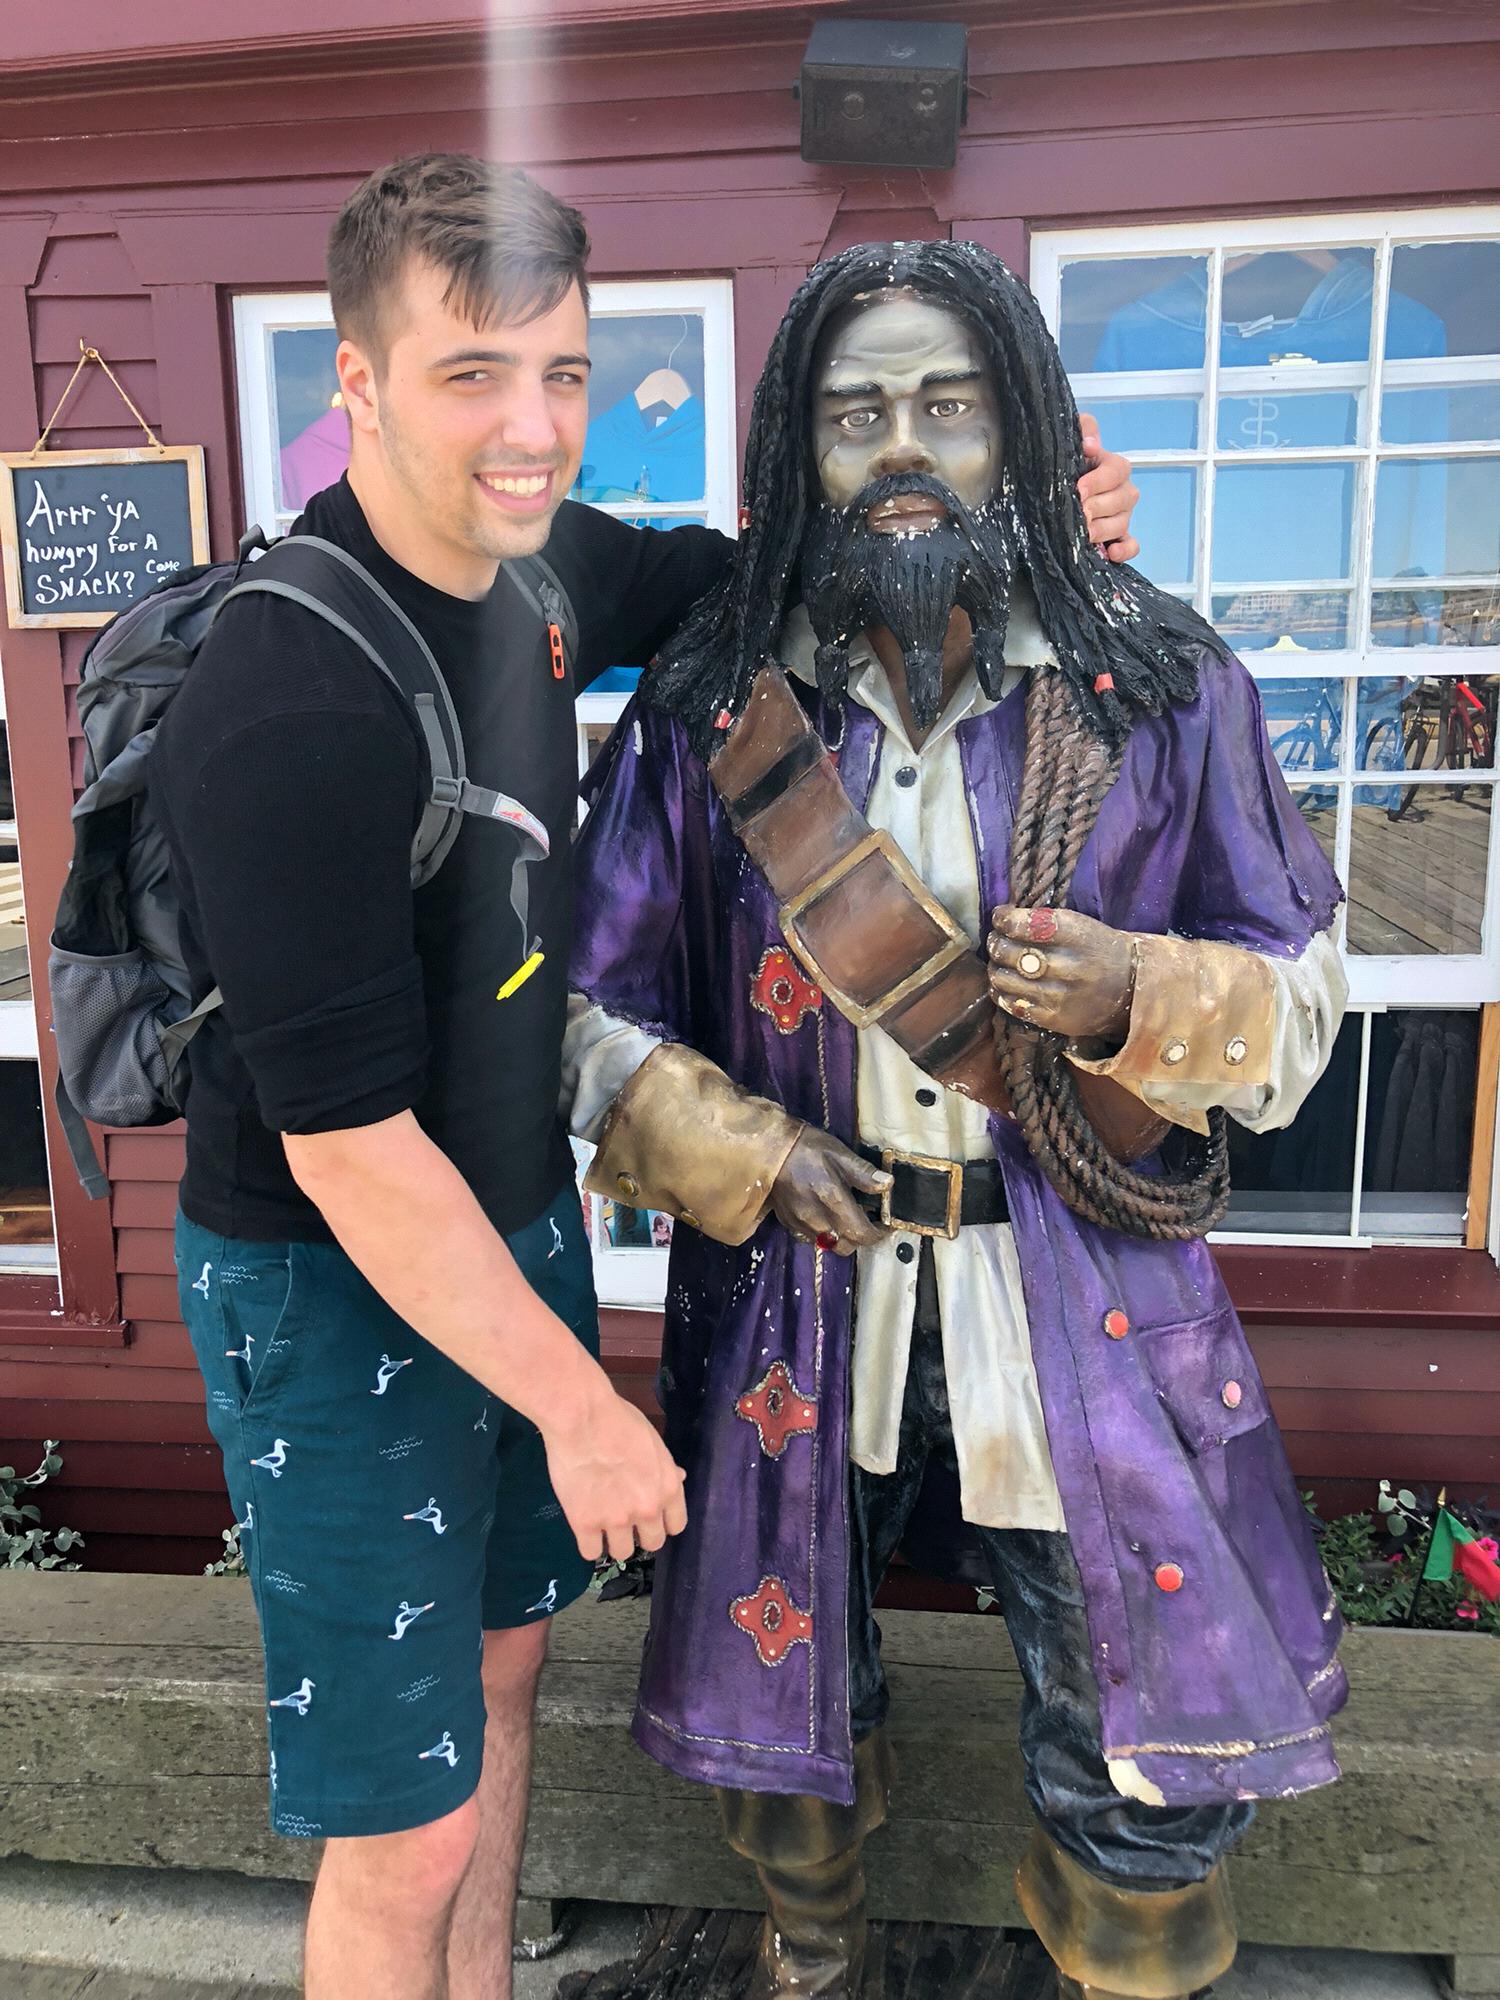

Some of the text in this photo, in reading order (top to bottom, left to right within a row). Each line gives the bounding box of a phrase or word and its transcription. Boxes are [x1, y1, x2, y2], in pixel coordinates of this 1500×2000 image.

[26, 480, 96, 534] Arrr
[144, 533, 158, 550] A
[35, 570, 135, 604] SNACK?
